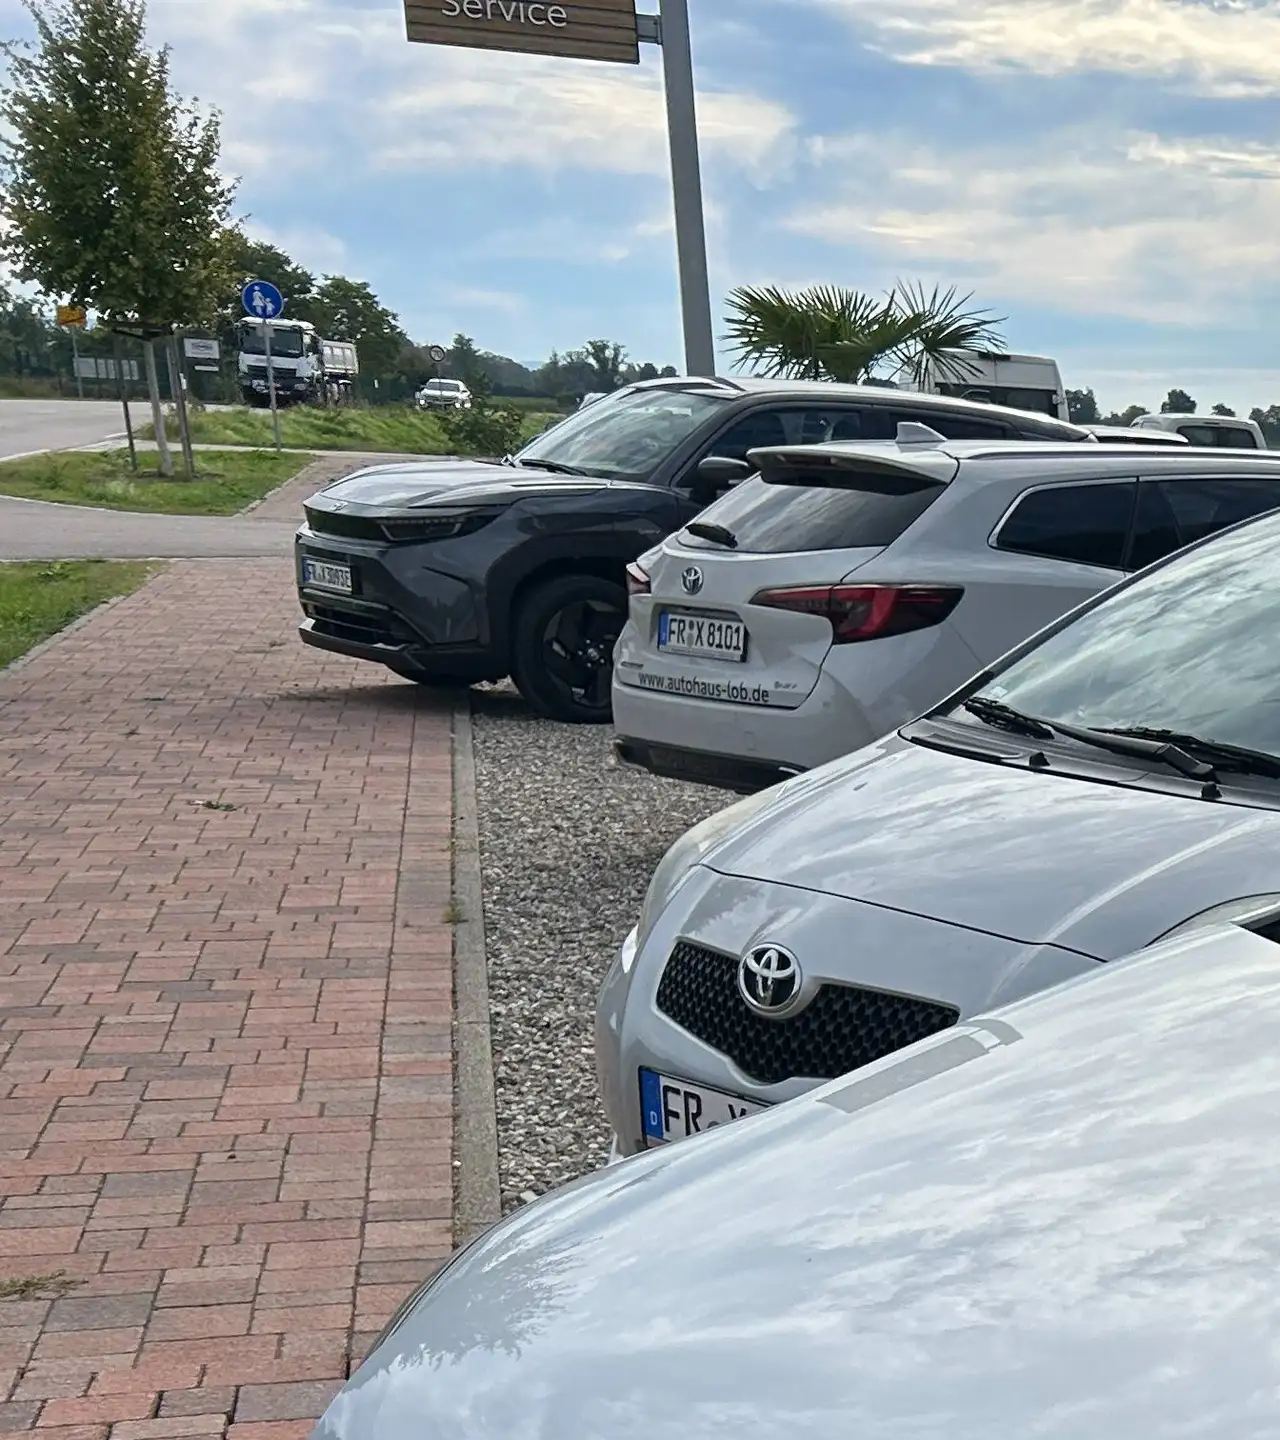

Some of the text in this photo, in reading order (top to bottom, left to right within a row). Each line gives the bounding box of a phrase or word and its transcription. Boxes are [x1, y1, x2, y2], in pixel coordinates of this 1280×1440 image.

[441, 0, 567, 27] Service
[668, 617, 742, 651] FR X 8101
[638, 671, 770, 703] www.autohaus-lob.de
[650, 1111, 658, 1126] D
[662, 1084, 703, 1137] FR
